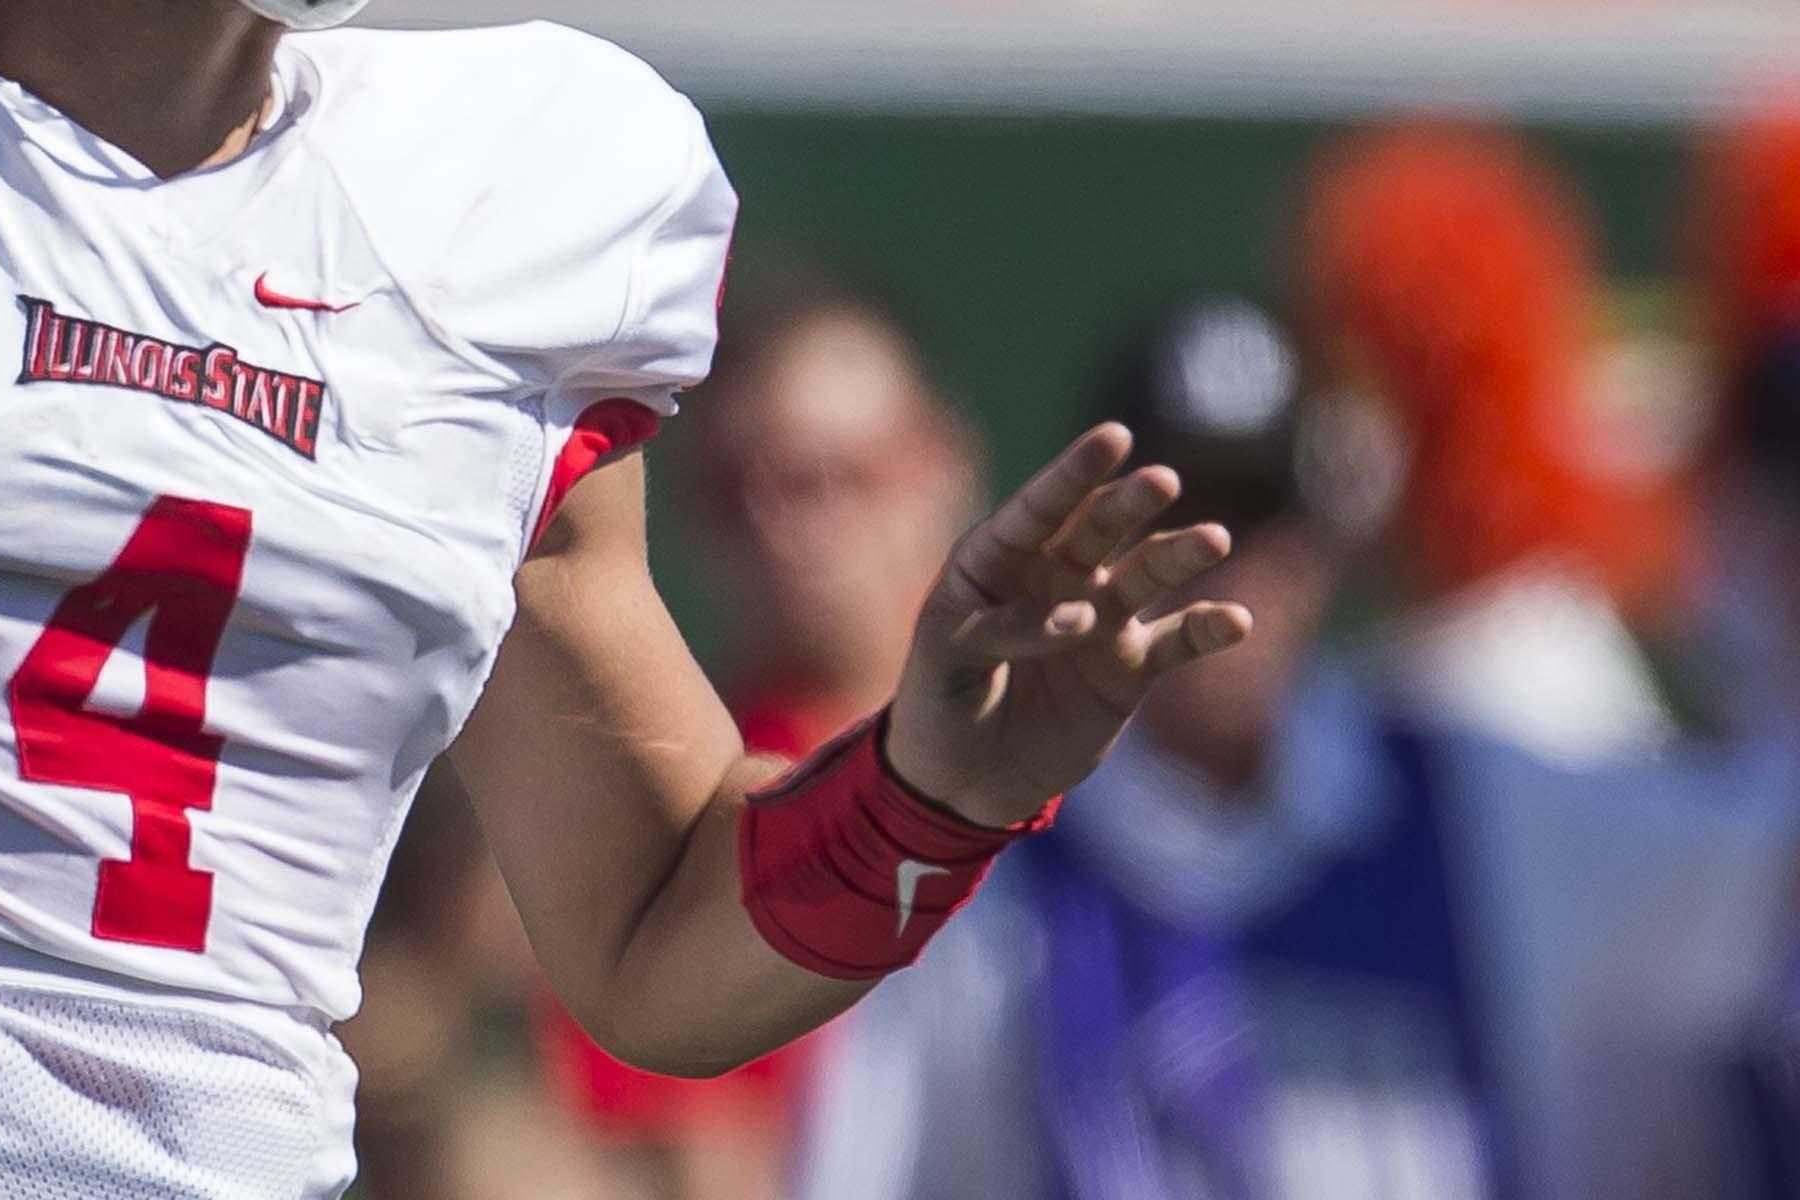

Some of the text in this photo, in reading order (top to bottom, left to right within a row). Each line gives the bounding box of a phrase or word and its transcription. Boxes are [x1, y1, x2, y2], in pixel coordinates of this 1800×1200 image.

[26, 300, 326, 461] ILLINOIS STATE
[7, 493, 254, 954] 4
